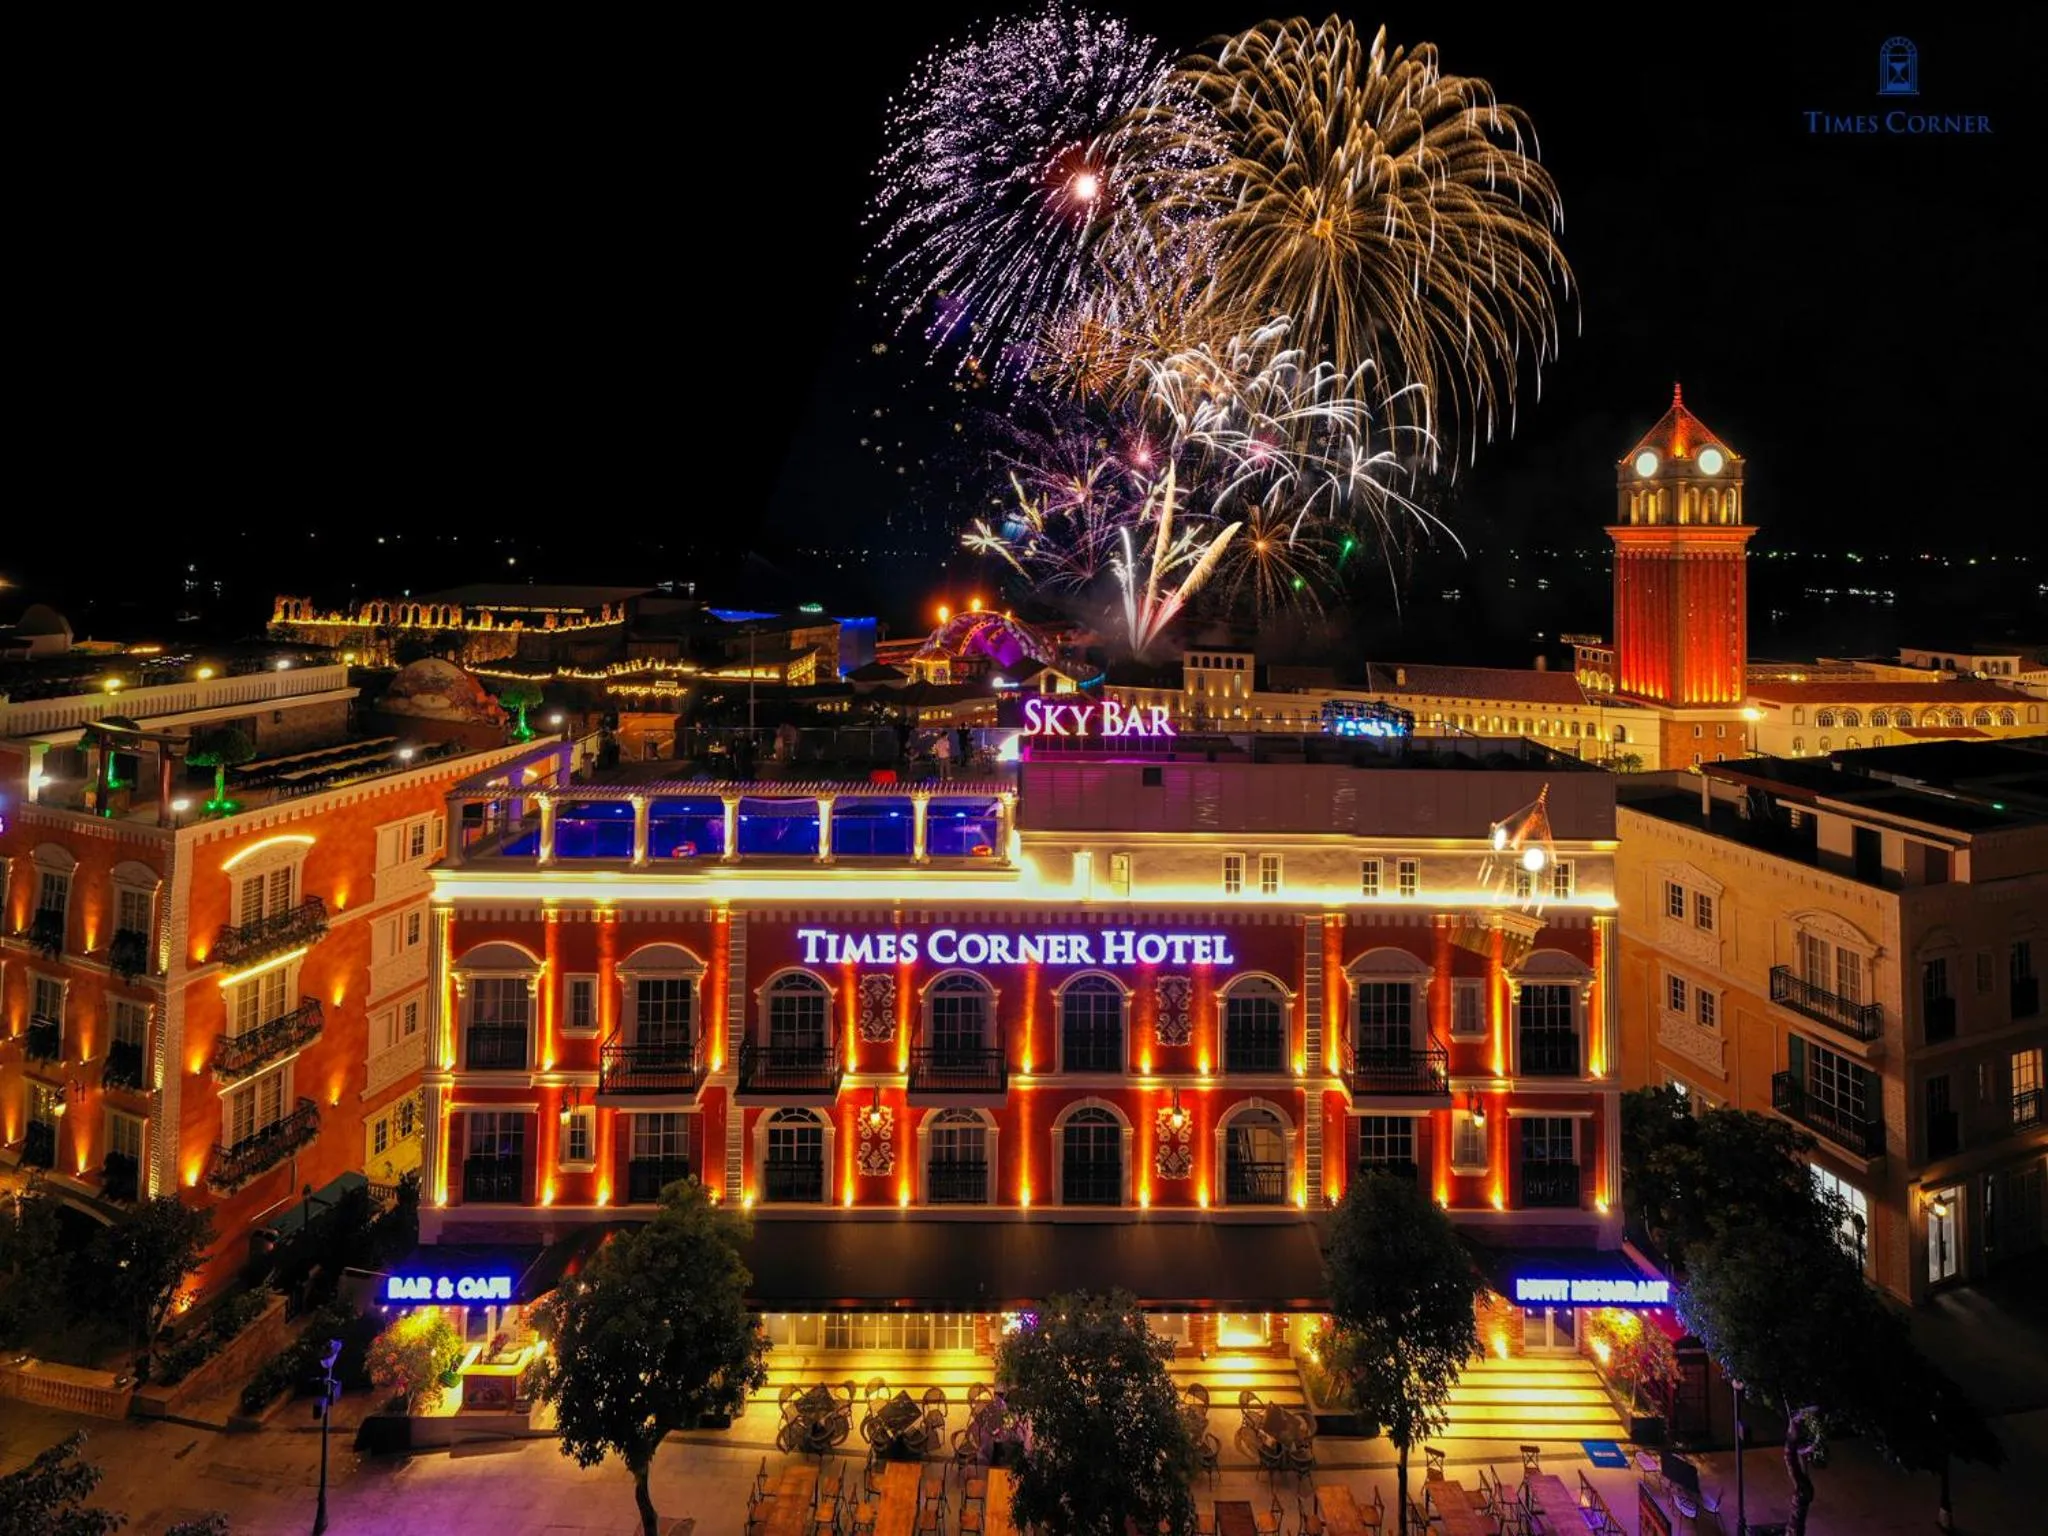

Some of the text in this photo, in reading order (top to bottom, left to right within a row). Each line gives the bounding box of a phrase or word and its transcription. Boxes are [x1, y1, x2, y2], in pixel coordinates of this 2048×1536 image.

[1020, 699, 1177, 737] SKY BAR
[797, 929, 1234, 965] TIMES CORNER HOTEL
[387, 1276, 433, 1299] BAR
[436, 1276, 454, 1299] &
